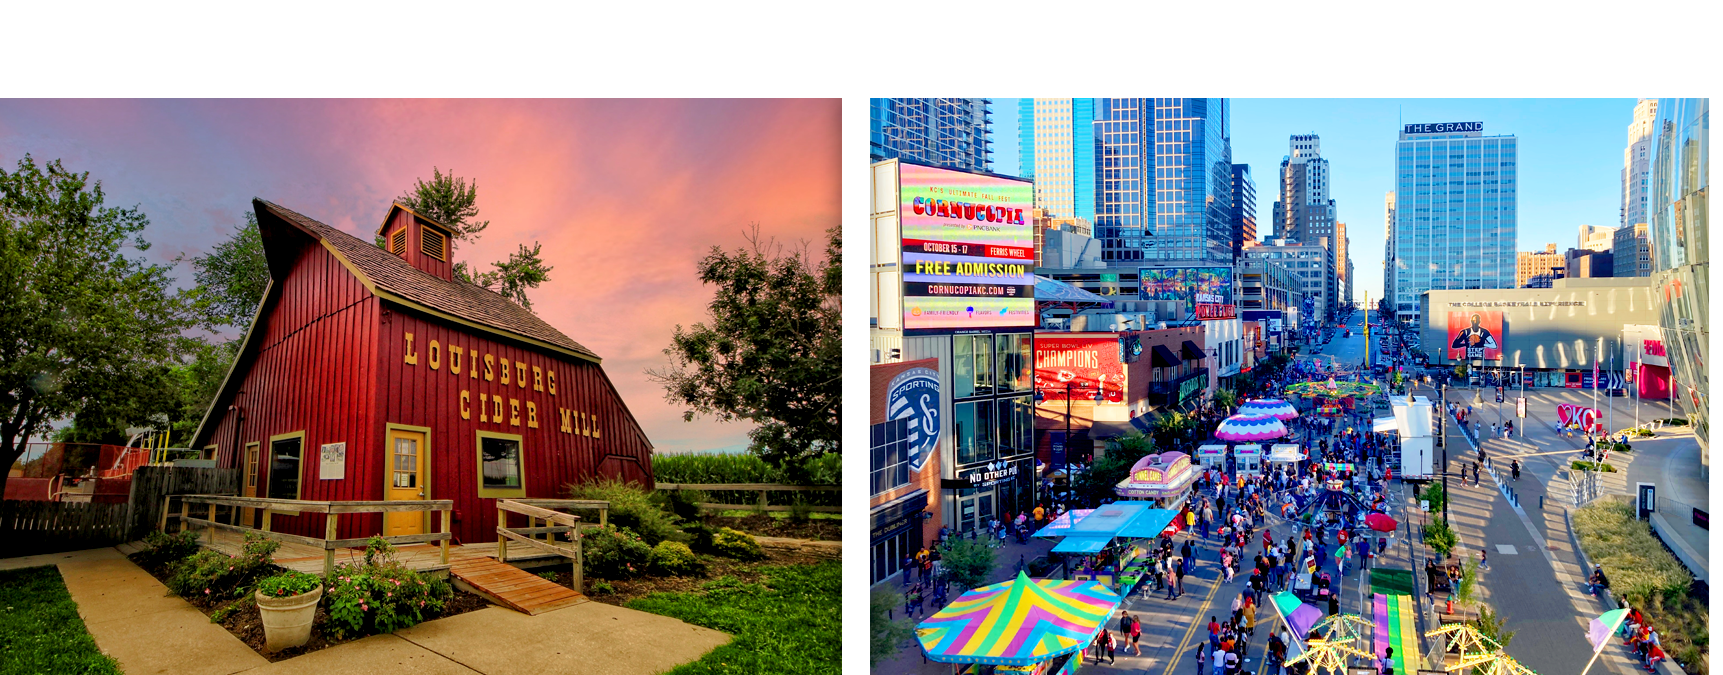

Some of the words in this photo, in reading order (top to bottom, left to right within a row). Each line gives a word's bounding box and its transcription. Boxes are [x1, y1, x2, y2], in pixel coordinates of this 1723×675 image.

[1406, 124, 1431, 132] THE
[1436, 122, 1483, 132] GRAND
[929, 186, 944, 194] KC'S
[948, 189, 977, 198] ULTIMATE
[981, 192, 994, 201] FALL
[913, 196, 1025, 225] CORNUCOPIA
[923, 242, 950, 253] OCTOBER
[951, 244, 958, 253] 15
[962, 245, 968, 254] 17
[990, 246, 1008, 256] FERRIS
[1009, 248, 1026, 258] WHEEL
[915, 259, 951, 276] FREE
[956, 261, 1025, 278] ADMISSION
[928, 285, 1004, 295] CORNUCOPIAKC.COM
[1196, 293, 1214, 302] KANSAS
[1215, 295, 1224, 303] CITY
[1197, 305, 1218, 318] POWER
[1223, 304, 1236, 317] LIGHT
[404, 331, 557, 396] LOUISBURG
[1036, 350, 1098, 369] CHAMPIONS
[890, 369, 921, 387] KANSAS
[924, 369, 940, 379] CITY
[892, 380, 940, 401] SPORTING
[460, 389, 539, 429] CIDER
[559, 407, 600, 439] MILL
[970, 473, 981, 484] NO
[984, 469, 1008, 480] OTHER
[1134, 469, 1148, 481] FUNNEL
[872, 529, 883, 538] THE
